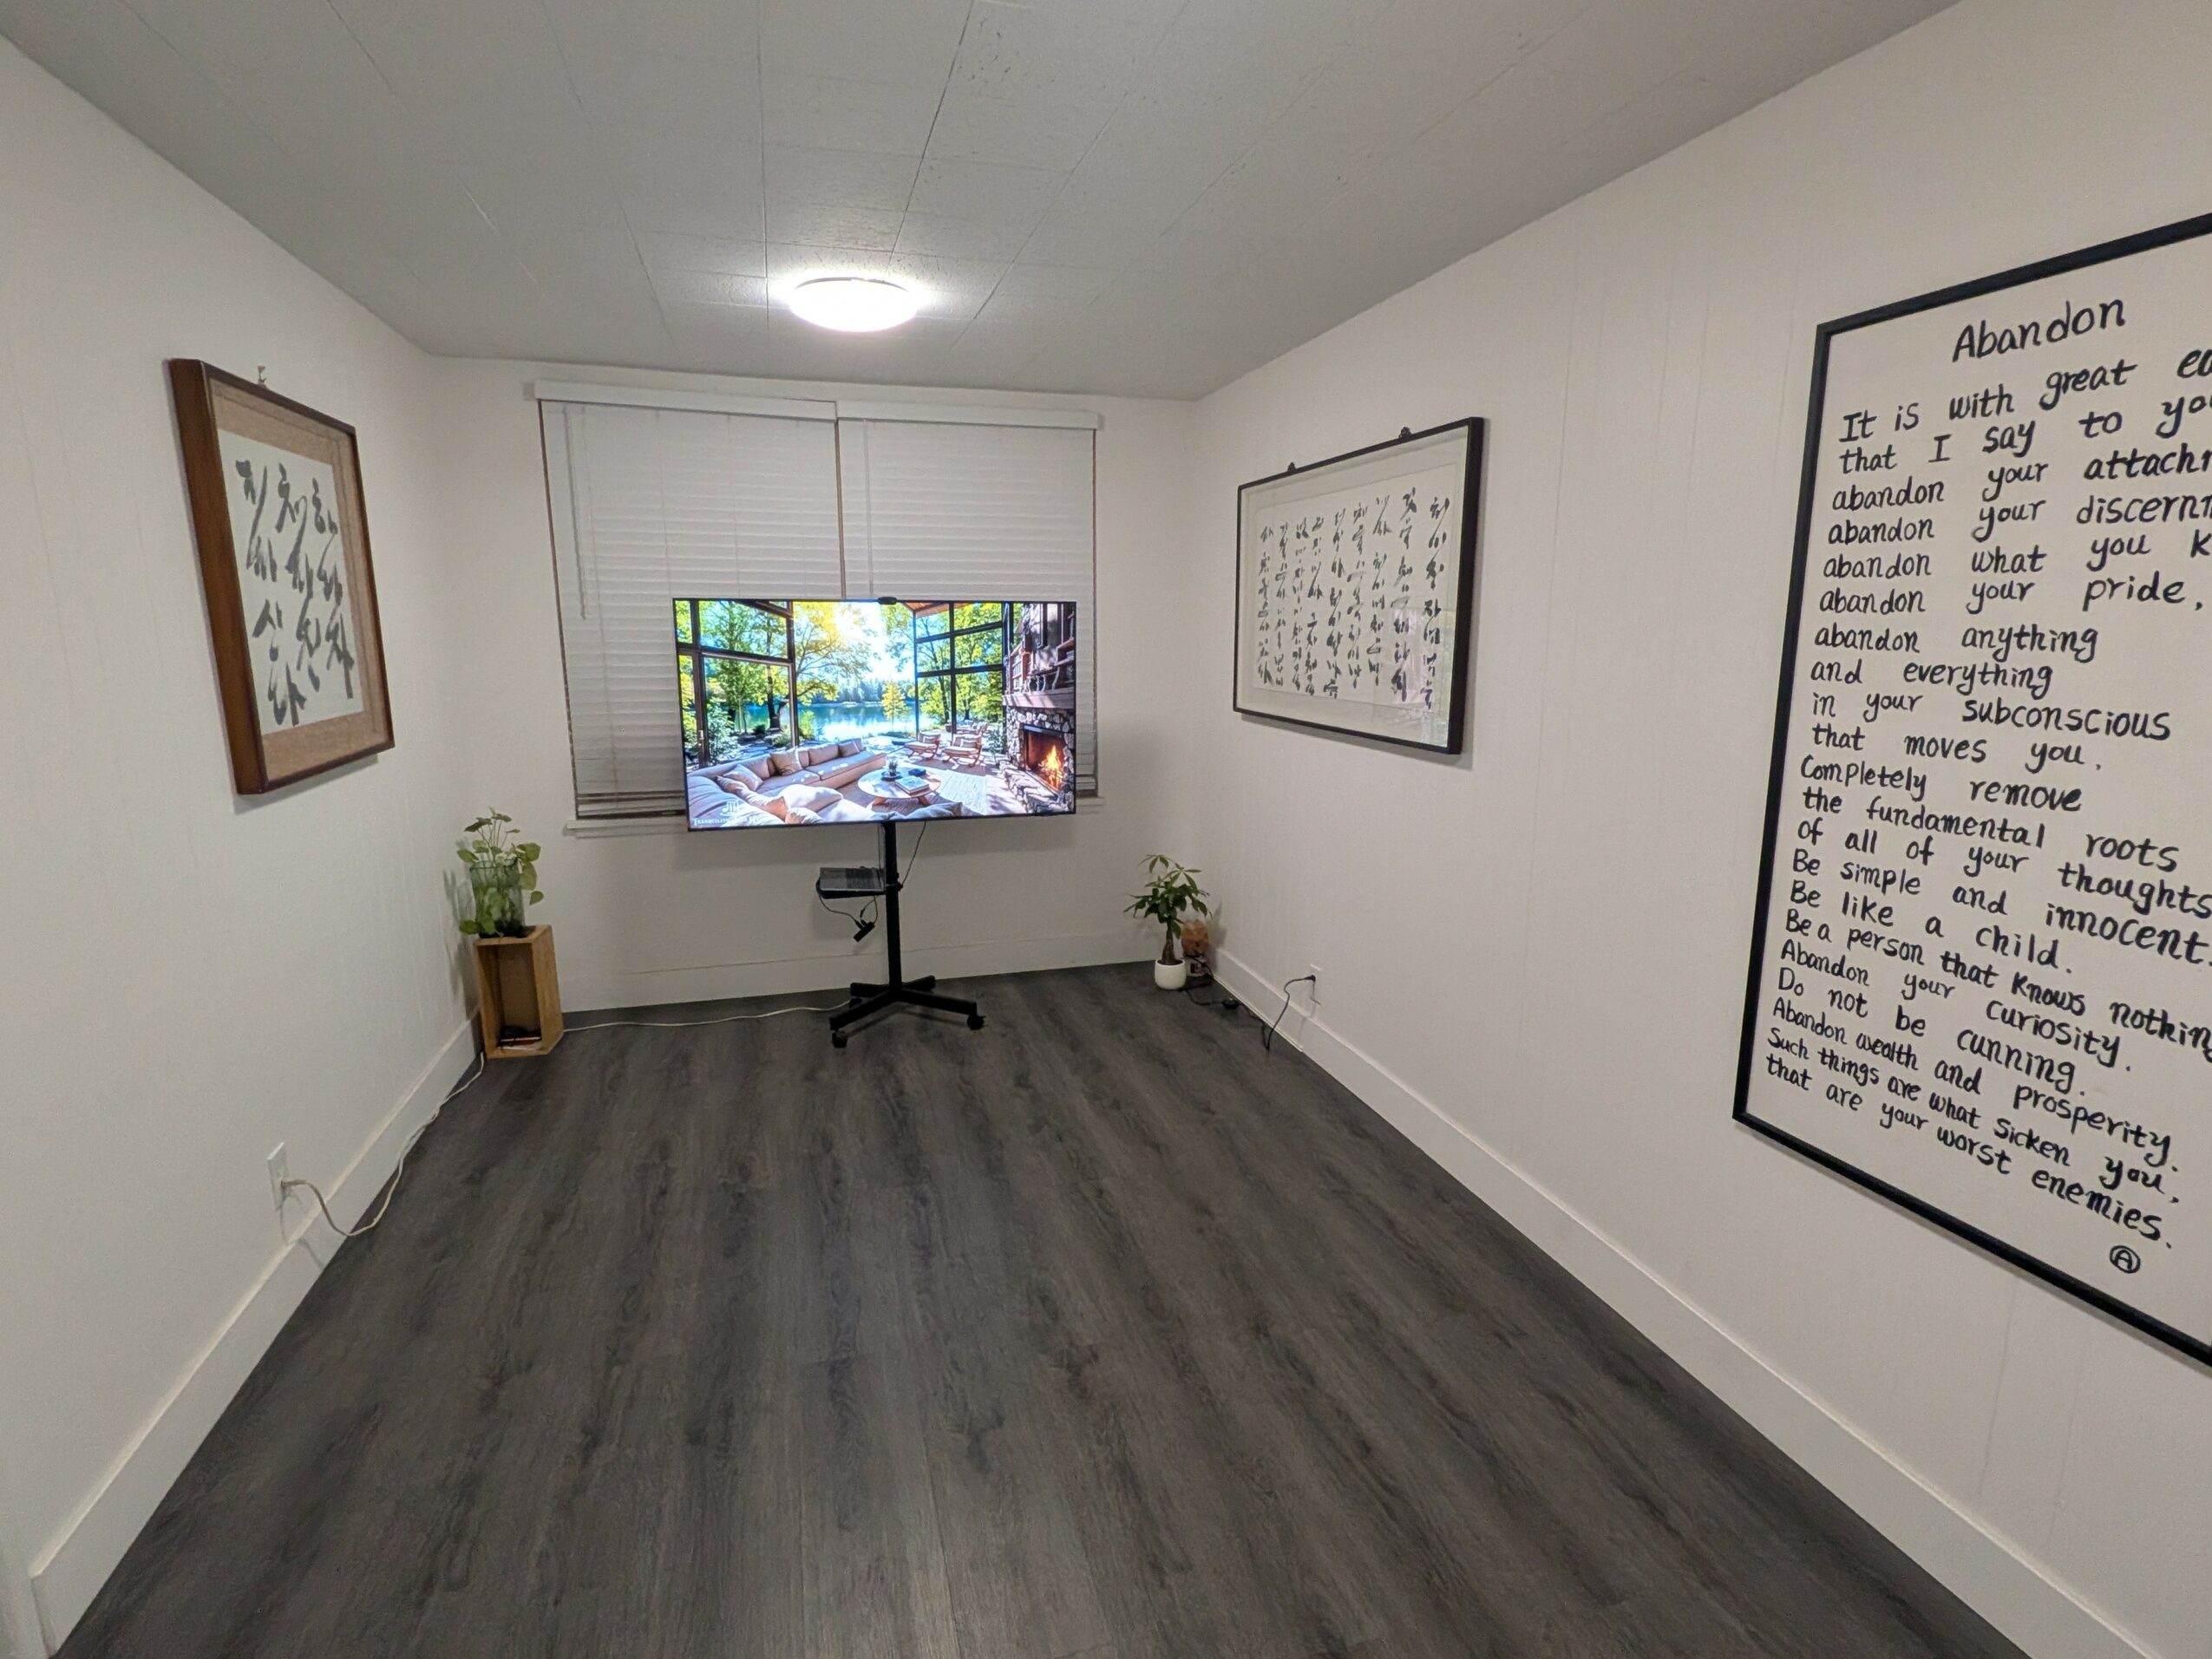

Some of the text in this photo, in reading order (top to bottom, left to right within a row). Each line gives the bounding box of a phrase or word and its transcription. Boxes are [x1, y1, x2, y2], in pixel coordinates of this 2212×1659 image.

[1952, 298, 2126, 363] Abandon
[1838, 409, 1878, 443] It
[1894, 402, 1920, 432] is
[1948, 382, 2015, 421] with
[2038, 358, 2138, 412] great
[1838, 395, 2212, 475] that I say to yo
[1831, 475, 1945, 512] abandon
[1981, 462, 2049, 503] your
[1828, 516, 1935, 546] abandon
[1970, 499, 2047, 544] your
[1823, 552, 1932, 580] abandon
[1971, 544, 2048, 574] what
[2085, 533, 2151, 572] you
[1819, 570, 2203, 616] abandon your pride,
[1814, 621, 2099, 664] abandon anything
[1810, 657, 2054, 701] and everything
[1811, 722, 1866, 752] that
[1903, 735, 1987, 764] moves
[1812, 691, 2171, 741] in your subconscious
[1800, 754, 2083, 813] Completely remove
[1802, 786, 2180, 873] the fundamental roots
[1792, 847, 1821, 877] Be
[1839, 861, 1921, 896] simple
[1952, 885, 2008, 916] and
[1797, 816, 2212, 919] of all of your thoughts
[1785, 908, 1813, 937] Be
[1816, 923, 1833, 944] a
[1846, 928, 1925, 966] person
[1939, 950, 1999, 989] that
[1790, 878, 2072, 974] Be like a child.
[1780, 938, 1870, 987] Abandon
[1900, 973, 1956, 1001] your
[1777, 966, 2085, 1097] Do not be cunning.
[1767, 1027, 1810, 1061] Such
[1816, 1047, 1880, 1087] things
[1887, 1075, 1922, 1102] are
[1928, 1092, 1982, 1130] what
[1772, 996, 2179, 1172] Abandon wealth and prosperity.
[1765, 1053, 2172, 1250] that are your worst enemies.
